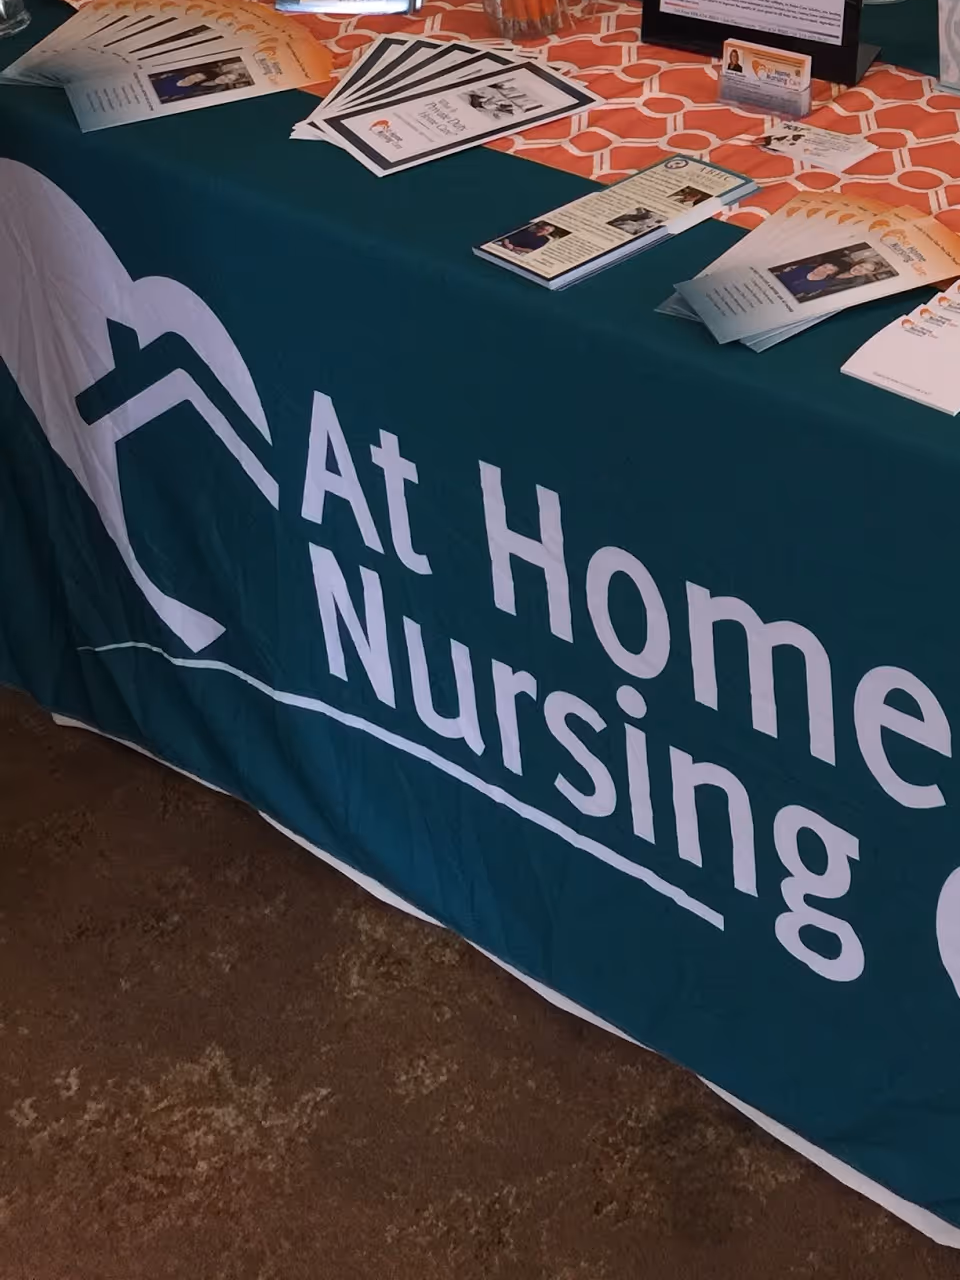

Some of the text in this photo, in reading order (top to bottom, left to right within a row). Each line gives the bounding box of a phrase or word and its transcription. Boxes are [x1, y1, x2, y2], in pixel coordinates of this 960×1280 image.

[301, 390, 952, 809] At Home
[308, 542, 864, 983] Nursing
